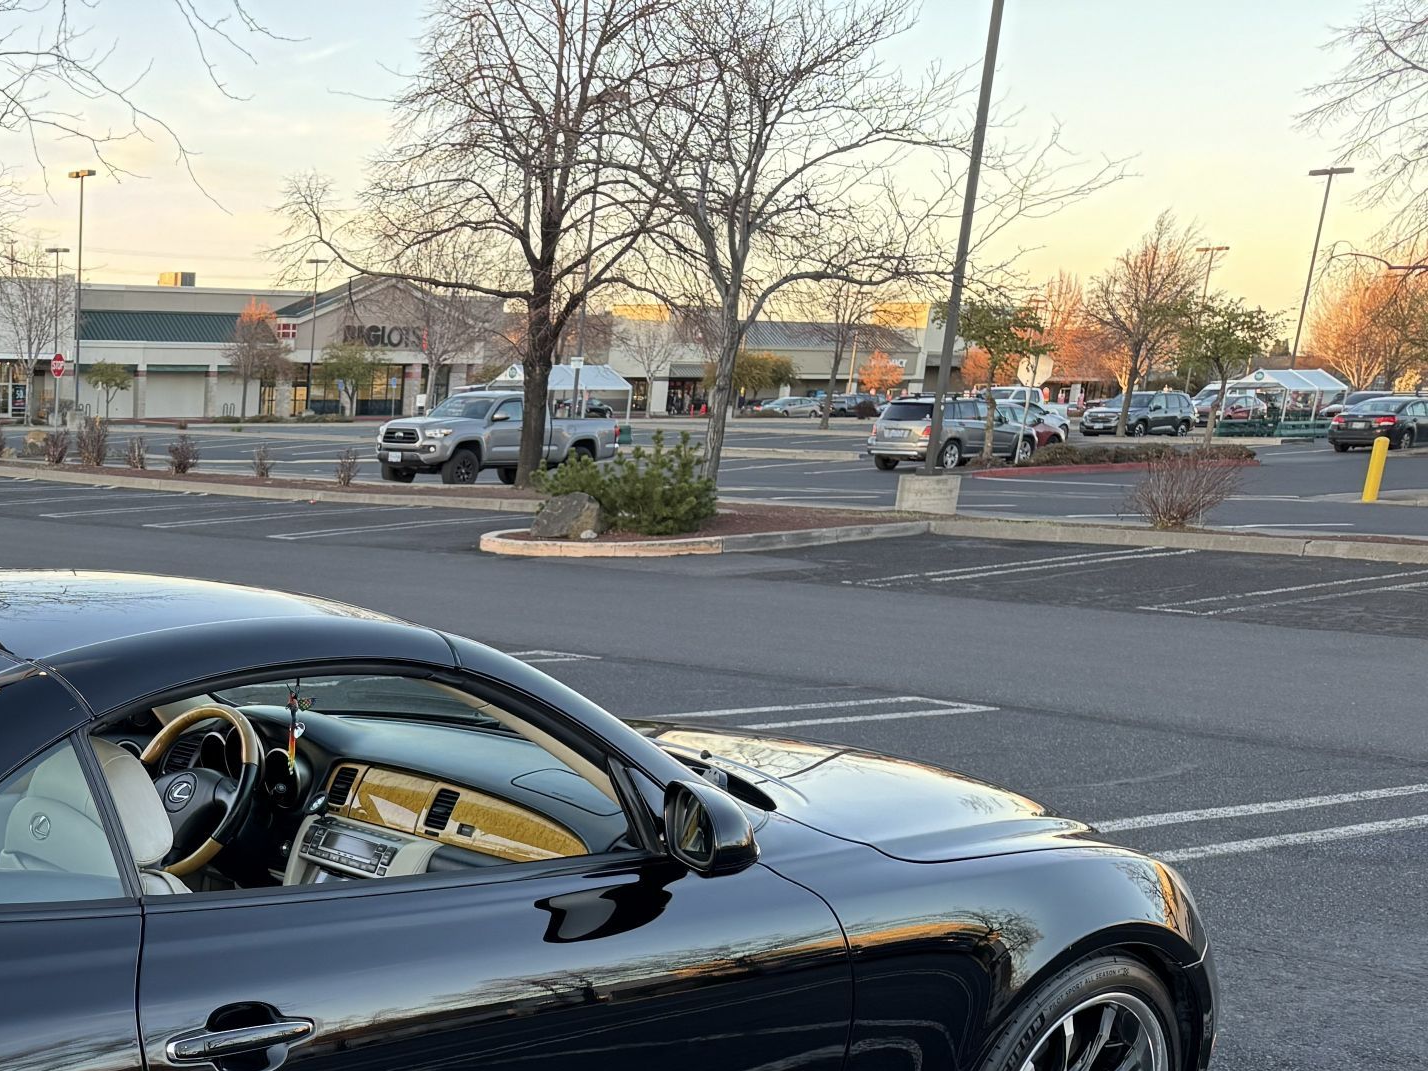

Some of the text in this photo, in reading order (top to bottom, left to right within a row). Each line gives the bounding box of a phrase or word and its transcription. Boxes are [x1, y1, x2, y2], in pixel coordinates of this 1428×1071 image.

[52, 361, 65, 369] STOP
[1048, 968, 1117, 1011] PILOT SPORT ALL SEASON
